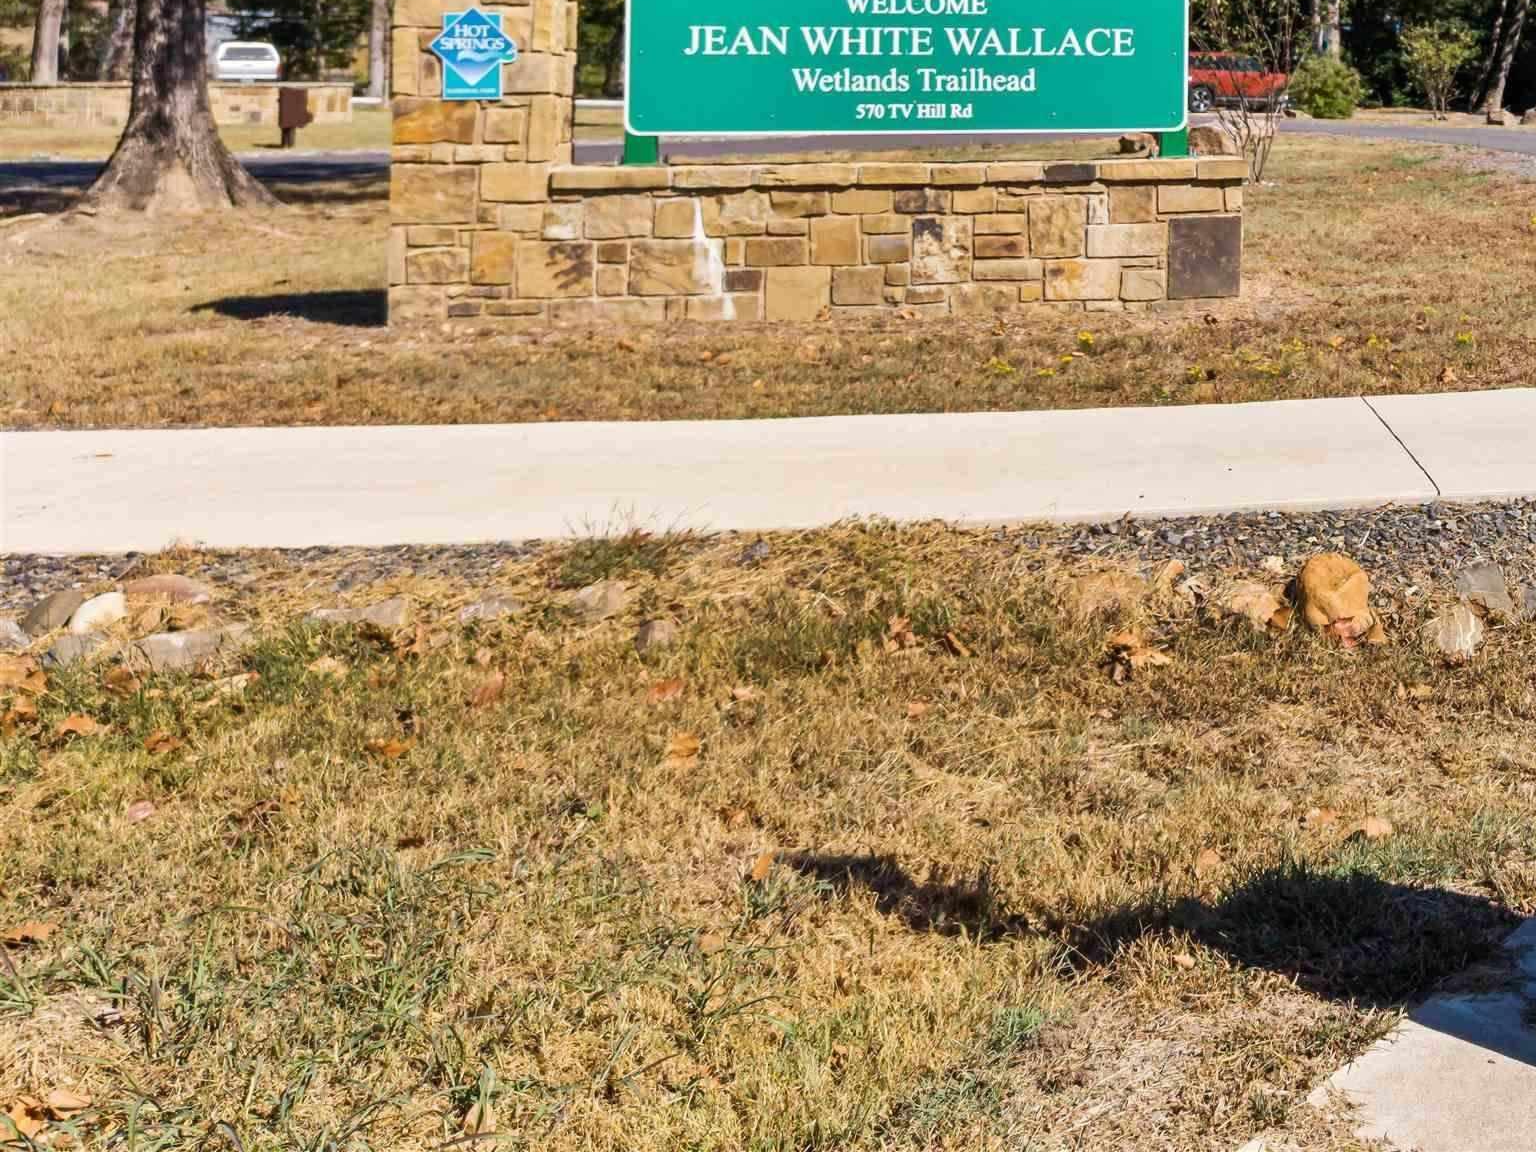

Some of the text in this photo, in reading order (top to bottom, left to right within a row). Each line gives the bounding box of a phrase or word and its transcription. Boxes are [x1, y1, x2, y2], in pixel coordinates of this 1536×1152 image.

[455, 24, 490, 37] HOT
[440, 37, 504, 50] SPRINGS
[683, 25, 1136, 57] JEAN WHITE WALLACE
[791, 67, 1037, 93] Wetlands Trailhead
[855, 103, 974, 119] 570 TV Hill Rd
